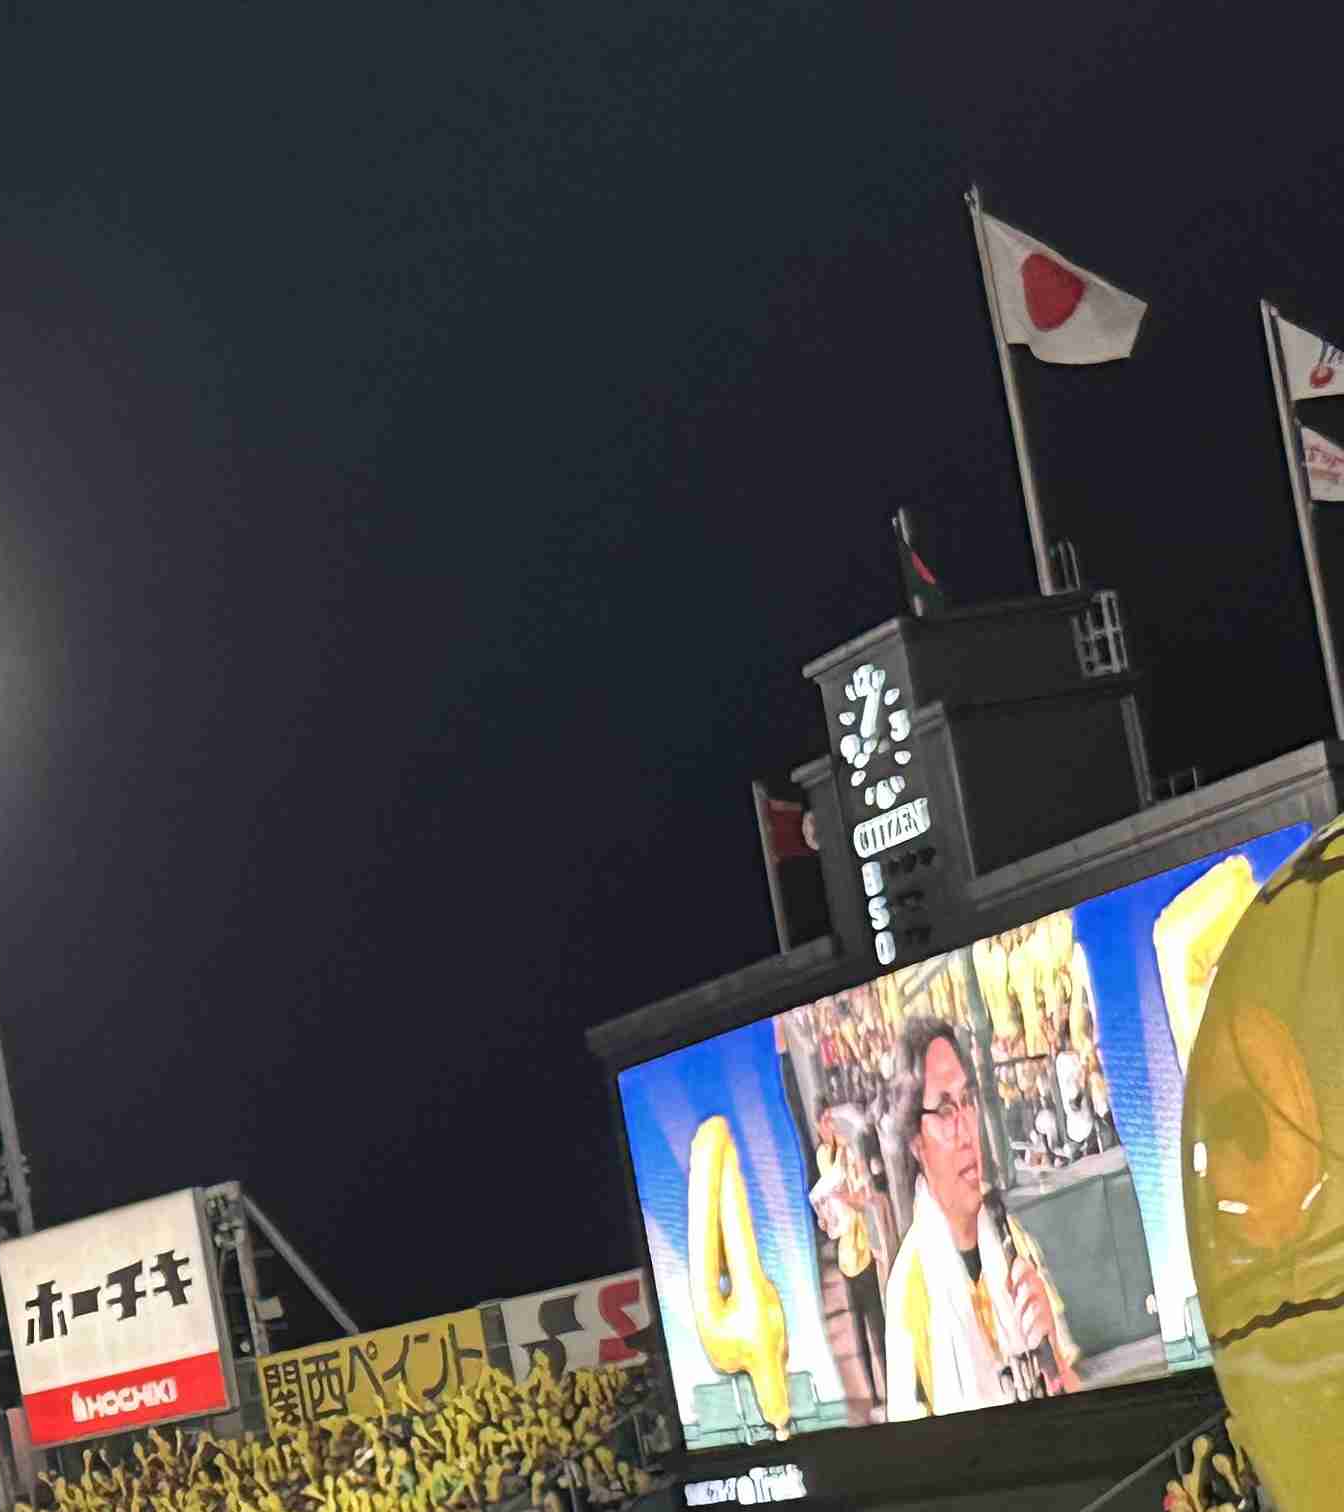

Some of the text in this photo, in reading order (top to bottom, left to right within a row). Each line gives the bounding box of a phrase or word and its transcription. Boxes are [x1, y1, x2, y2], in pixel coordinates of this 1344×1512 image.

[25, 1249, 192, 1346] ホーチキ
[86, 1377, 178, 1420] HOCHIKI
[263, 1323, 483, 1428] 関西ペイント
